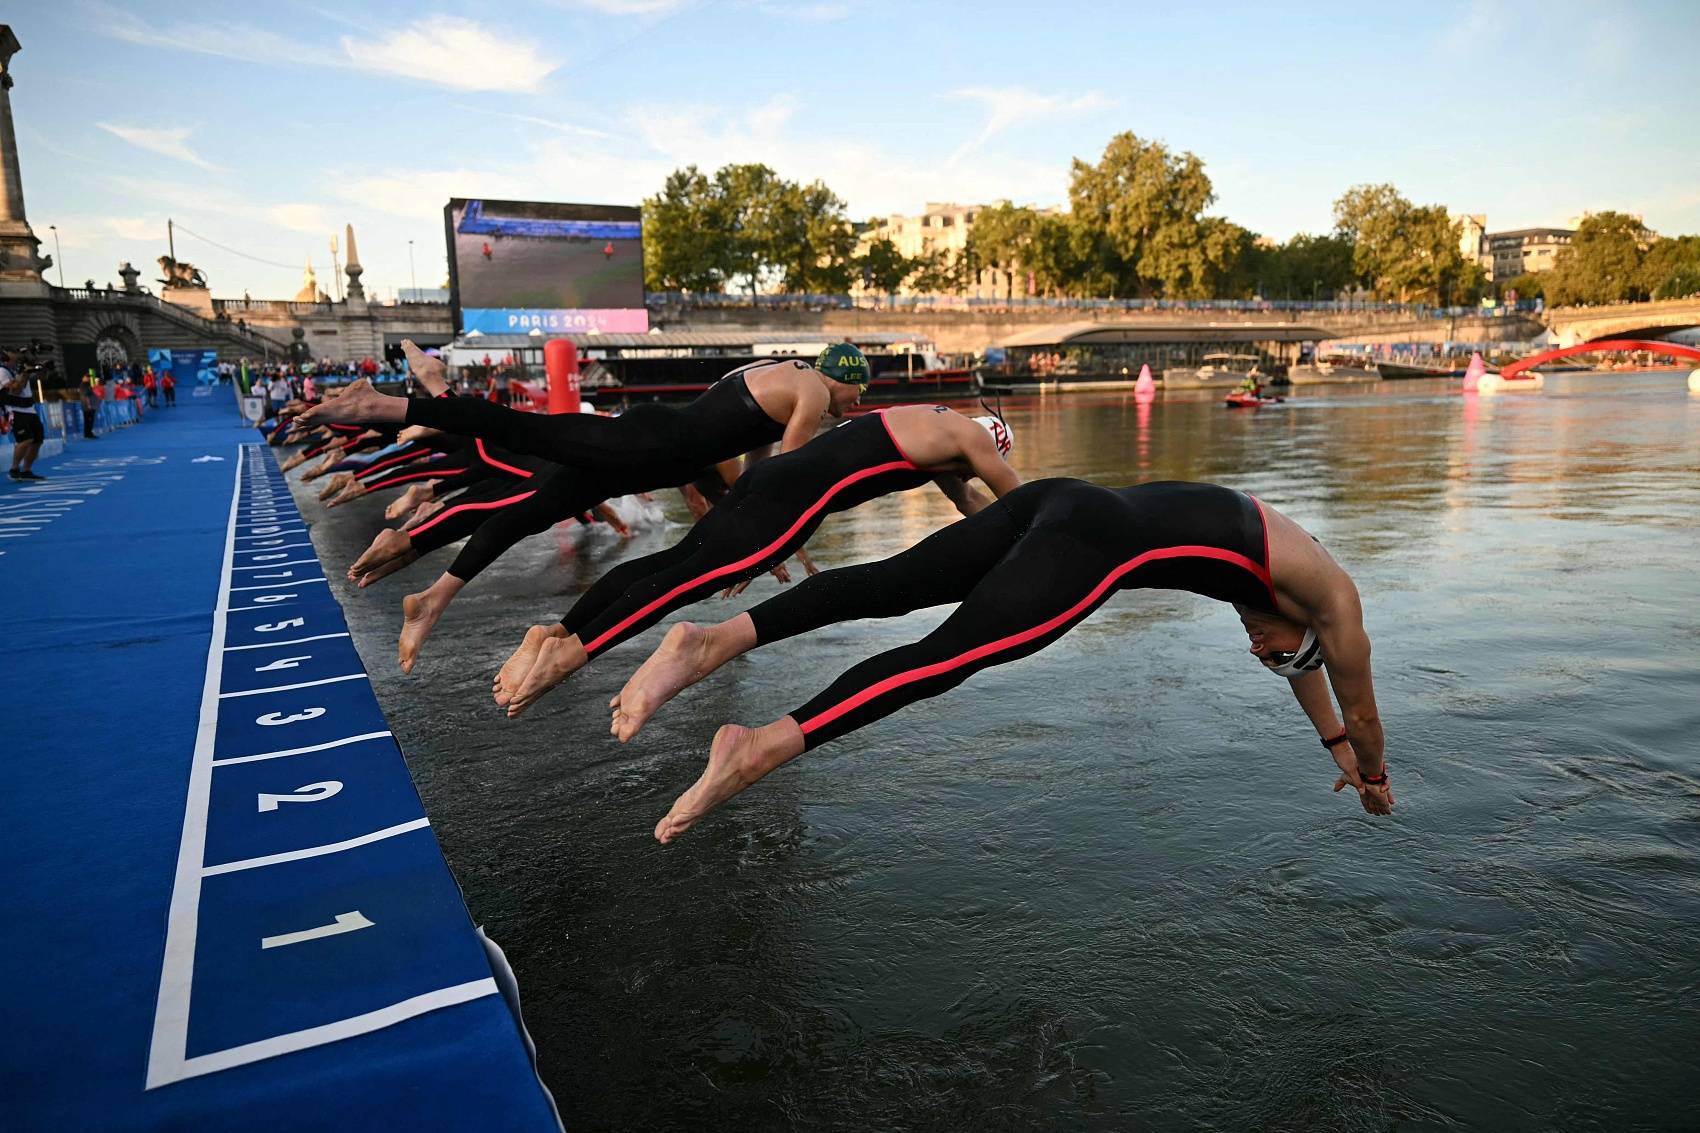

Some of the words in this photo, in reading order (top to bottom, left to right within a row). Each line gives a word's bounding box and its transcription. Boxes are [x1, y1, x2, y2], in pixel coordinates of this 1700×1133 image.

[508, 314, 558, 328] PARIS
[563, 314, 608, 328] 2024
[838, 355, 867, 368] AUS
[844, 372, 863, 381] LEE
[252, 553, 289, 561] 8
[253, 570, 293, 579] 7
[253, 593, 298, 603] 6
[254, 616, 305, 632] 5
[255, 655, 312, 672] 4
[256, 707, 326, 726] 3
[258, 780, 344, 813] 2
[261, 910, 376, 950] 1
